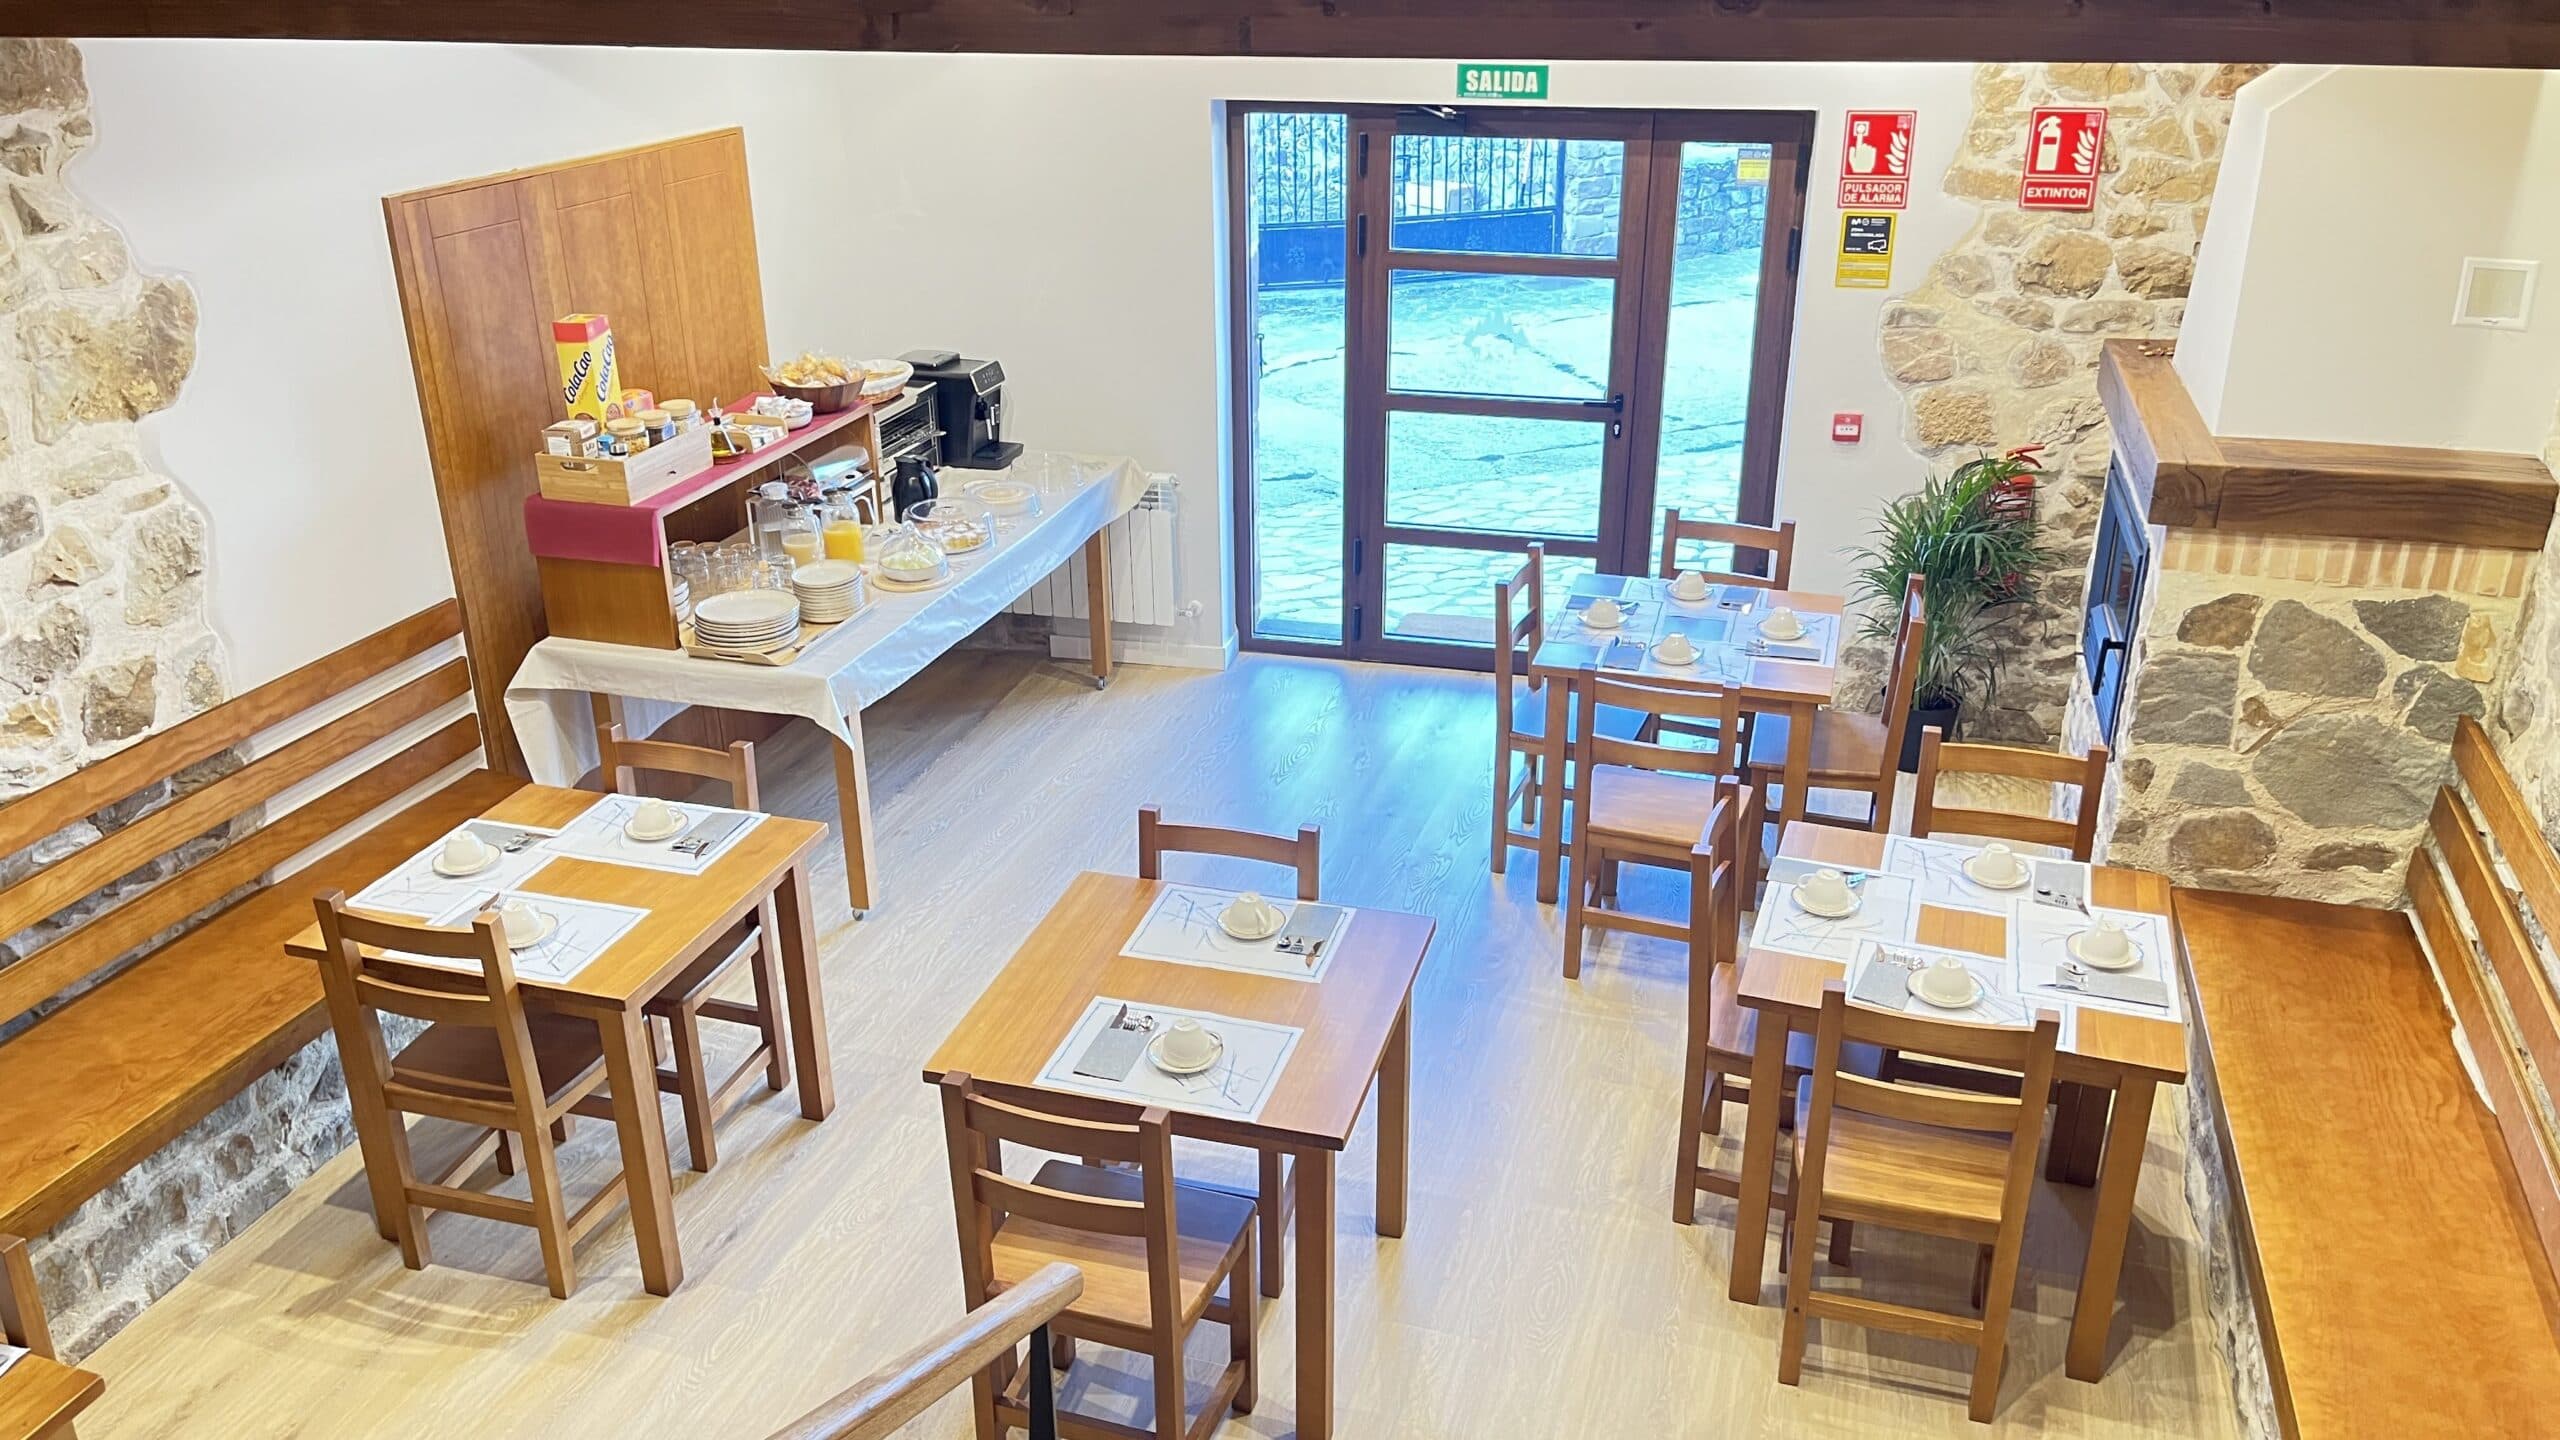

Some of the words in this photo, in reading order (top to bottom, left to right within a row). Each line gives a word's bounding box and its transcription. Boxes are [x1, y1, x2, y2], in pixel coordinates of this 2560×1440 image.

[1466, 70, 1538, 93] SALIDA
[1845, 183, 1902, 193] PULSADOR
[2026, 187, 2087, 199] EXTINTOR
[1844, 193, 1858, 203] DE
[1860, 193, 1901, 203] ALARMA
